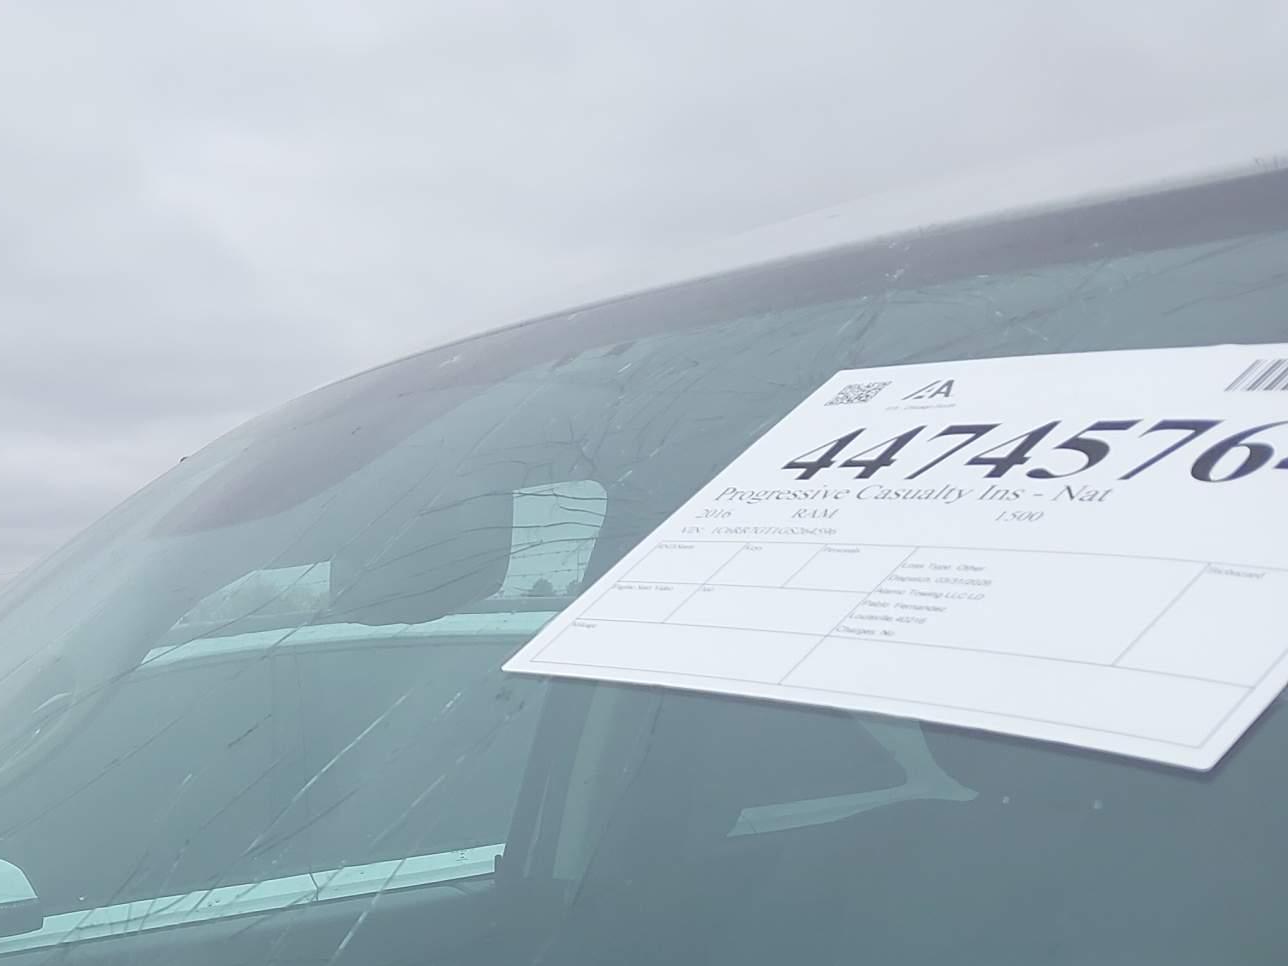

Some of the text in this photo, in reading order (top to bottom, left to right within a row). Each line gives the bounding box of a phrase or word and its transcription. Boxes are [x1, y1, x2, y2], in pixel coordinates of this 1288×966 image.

[780, 418, 1288, 483] 4474576
[715, 484, 850, 505] Progressive
[856, 484, 973, 505] Casualty
[979, 485, 1024, 501] Ins
[1050, 485, 1113, 502] Nat
[792, 508, 839, 519] RAM
[994, 510, 1045, 522] 1500
